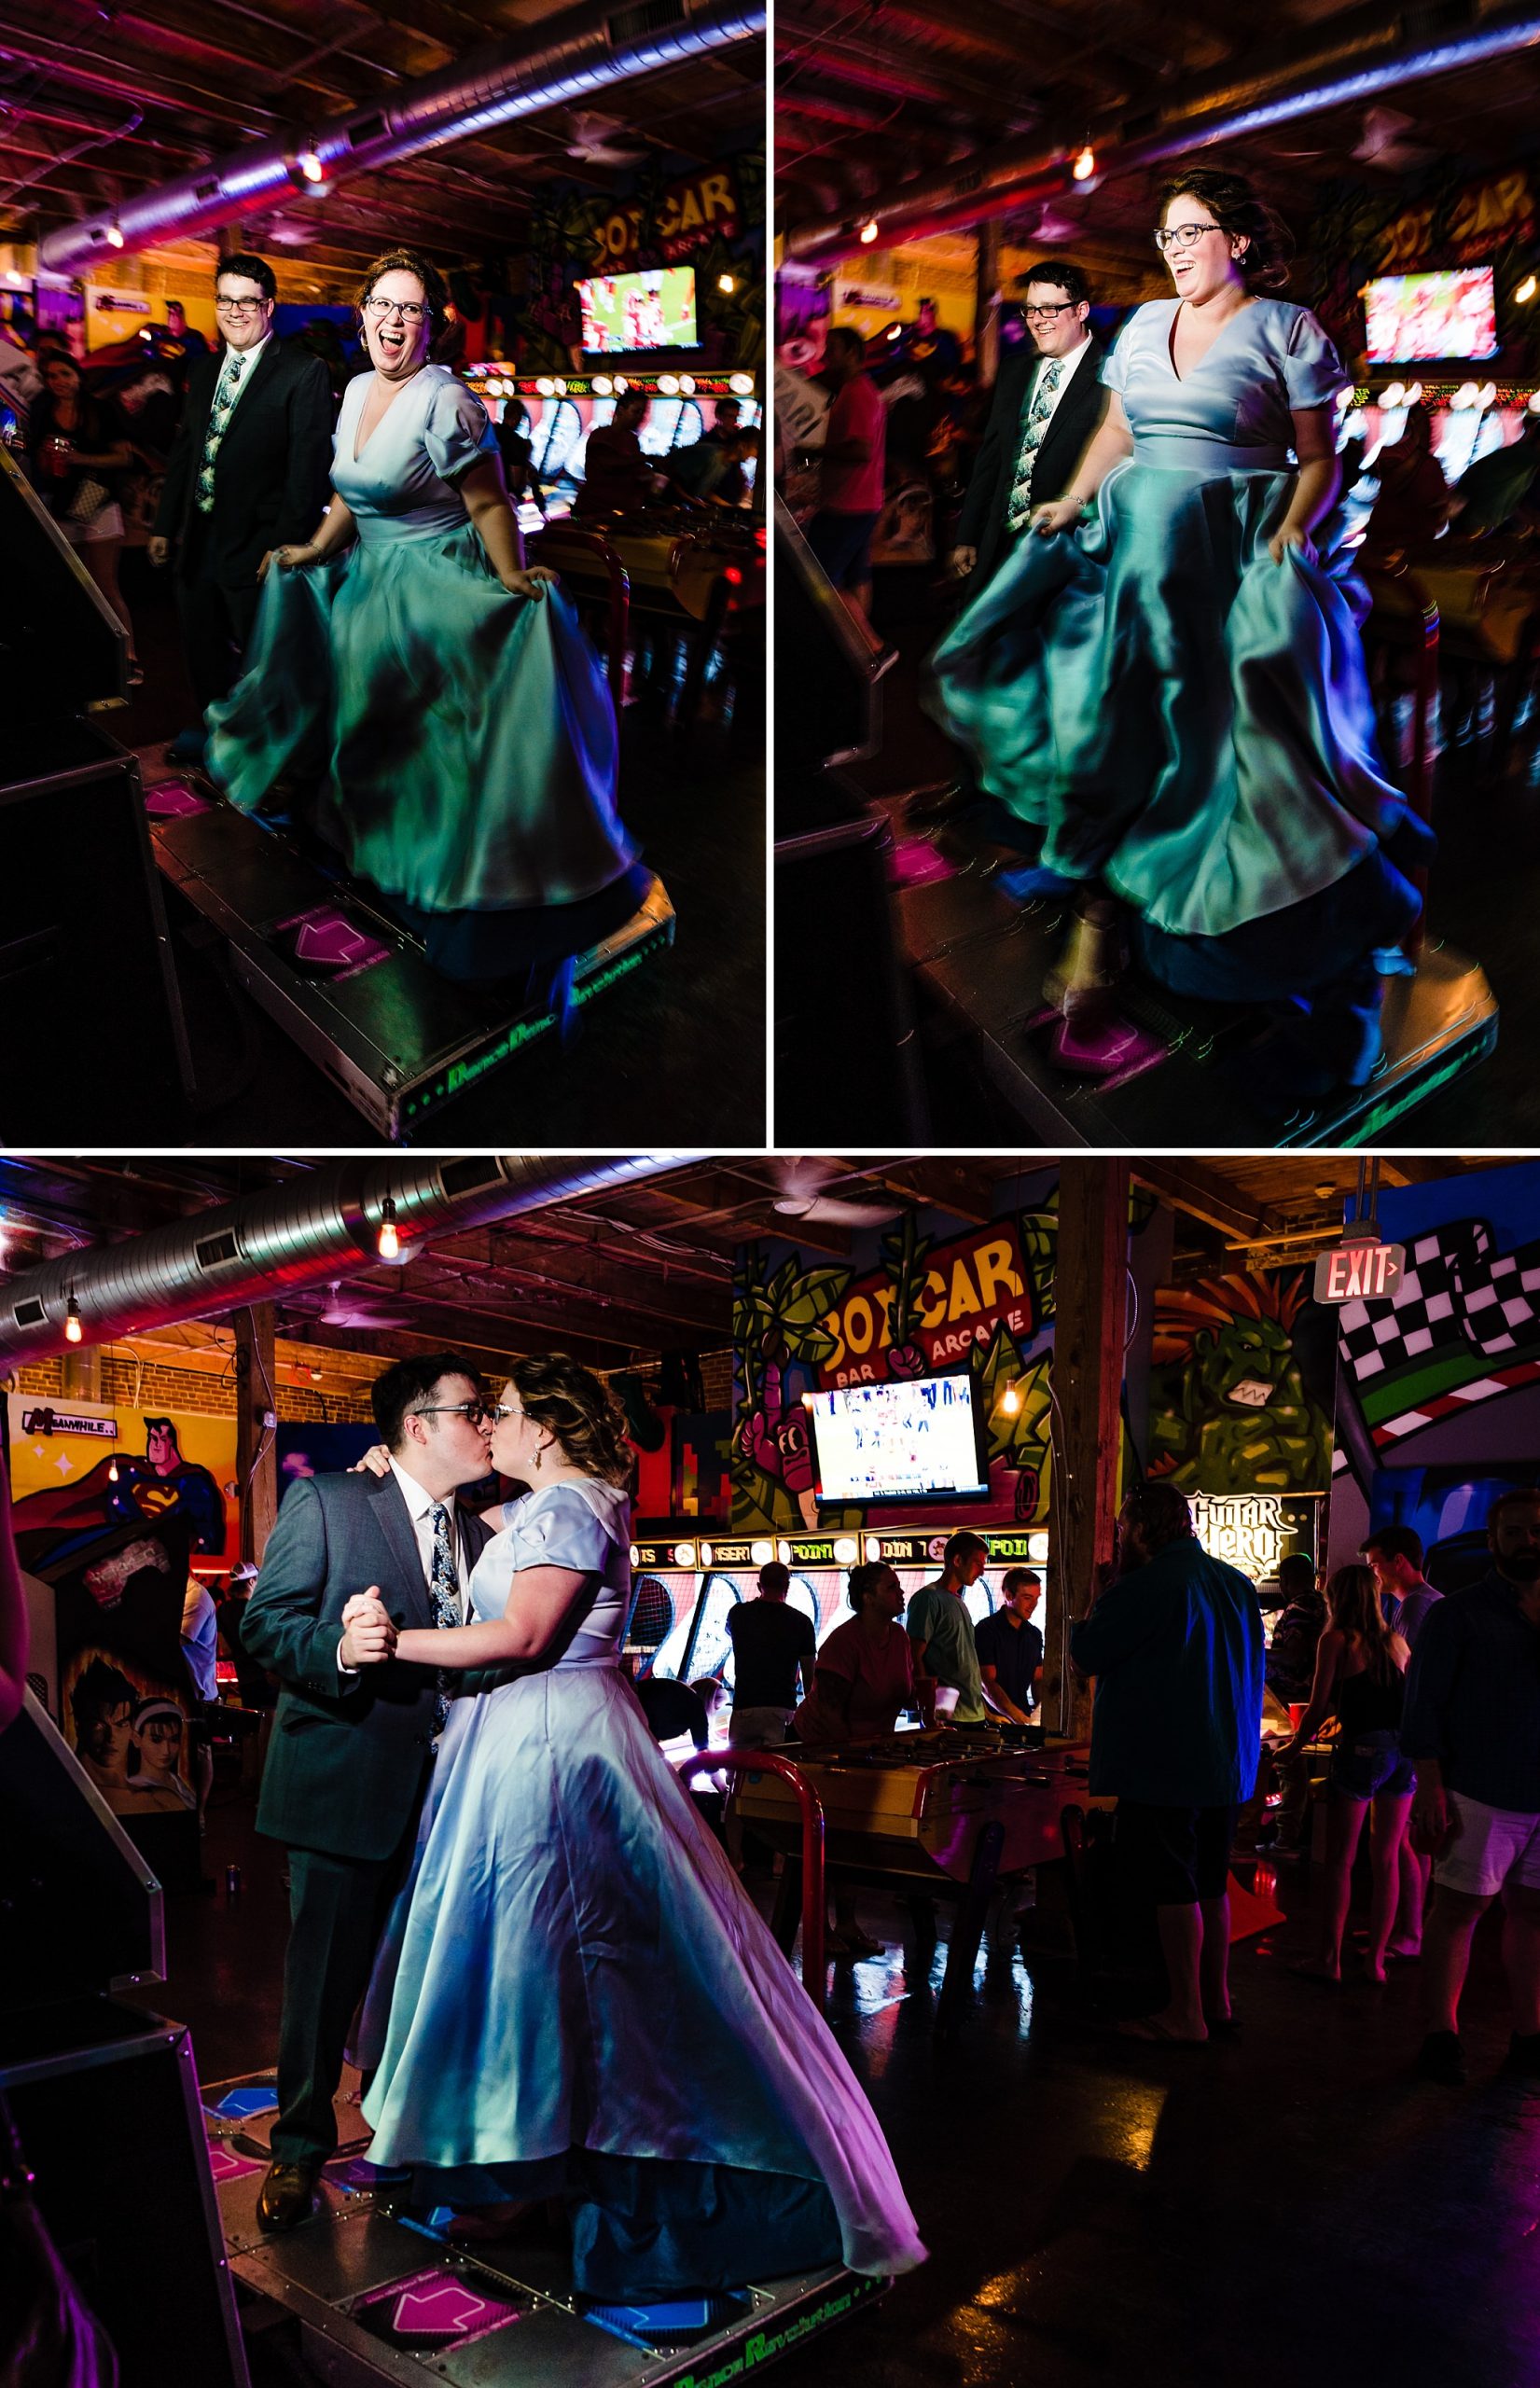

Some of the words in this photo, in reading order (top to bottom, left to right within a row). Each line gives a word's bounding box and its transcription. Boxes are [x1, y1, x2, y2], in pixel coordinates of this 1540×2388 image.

[1327, 1246, 1392, 1298] EXIT
[933, 1310, 1024, 1360] ARCAE
[836, 1364, 875, 1388] BAR
